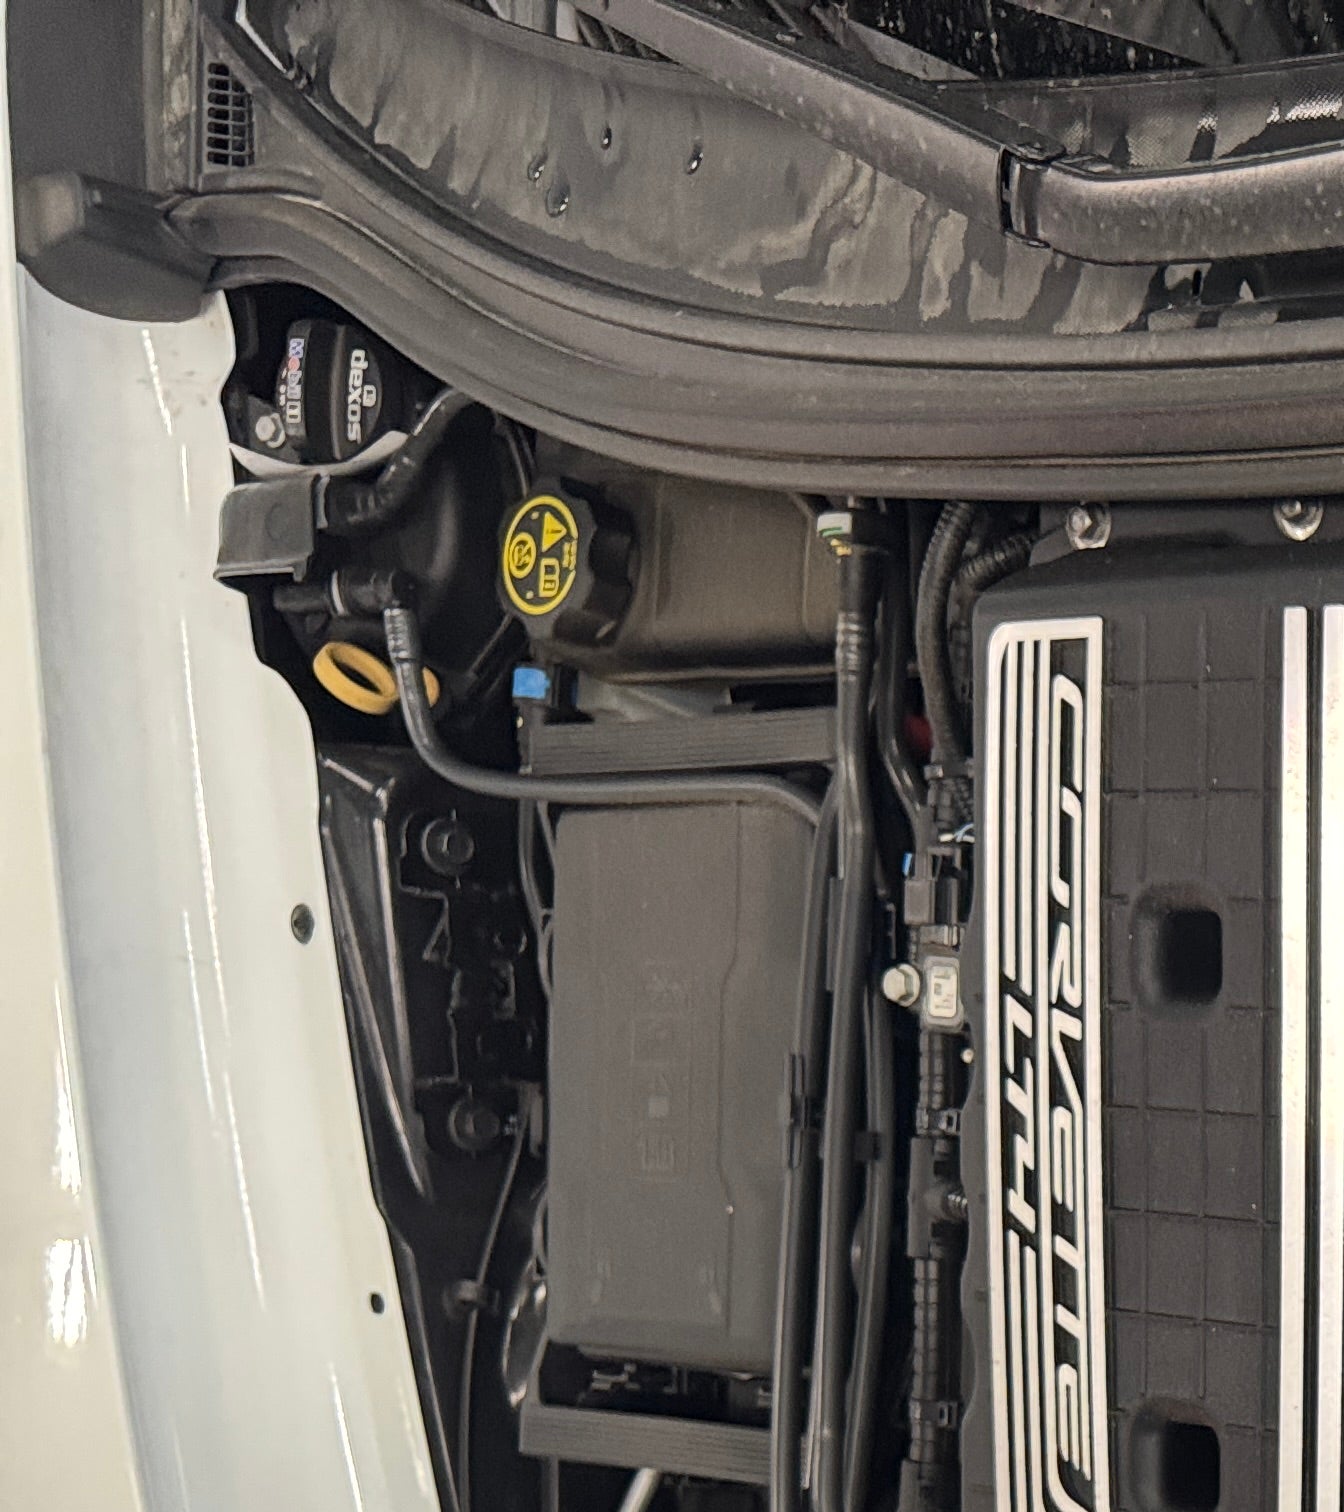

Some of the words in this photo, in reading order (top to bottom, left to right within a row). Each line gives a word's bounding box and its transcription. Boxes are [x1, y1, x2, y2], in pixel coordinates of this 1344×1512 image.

[347, 350, 368, 444] dexos
[1005, 993, 1036, 1233] LT4
[1051, 673, 1091, 1482] CORVETTE
